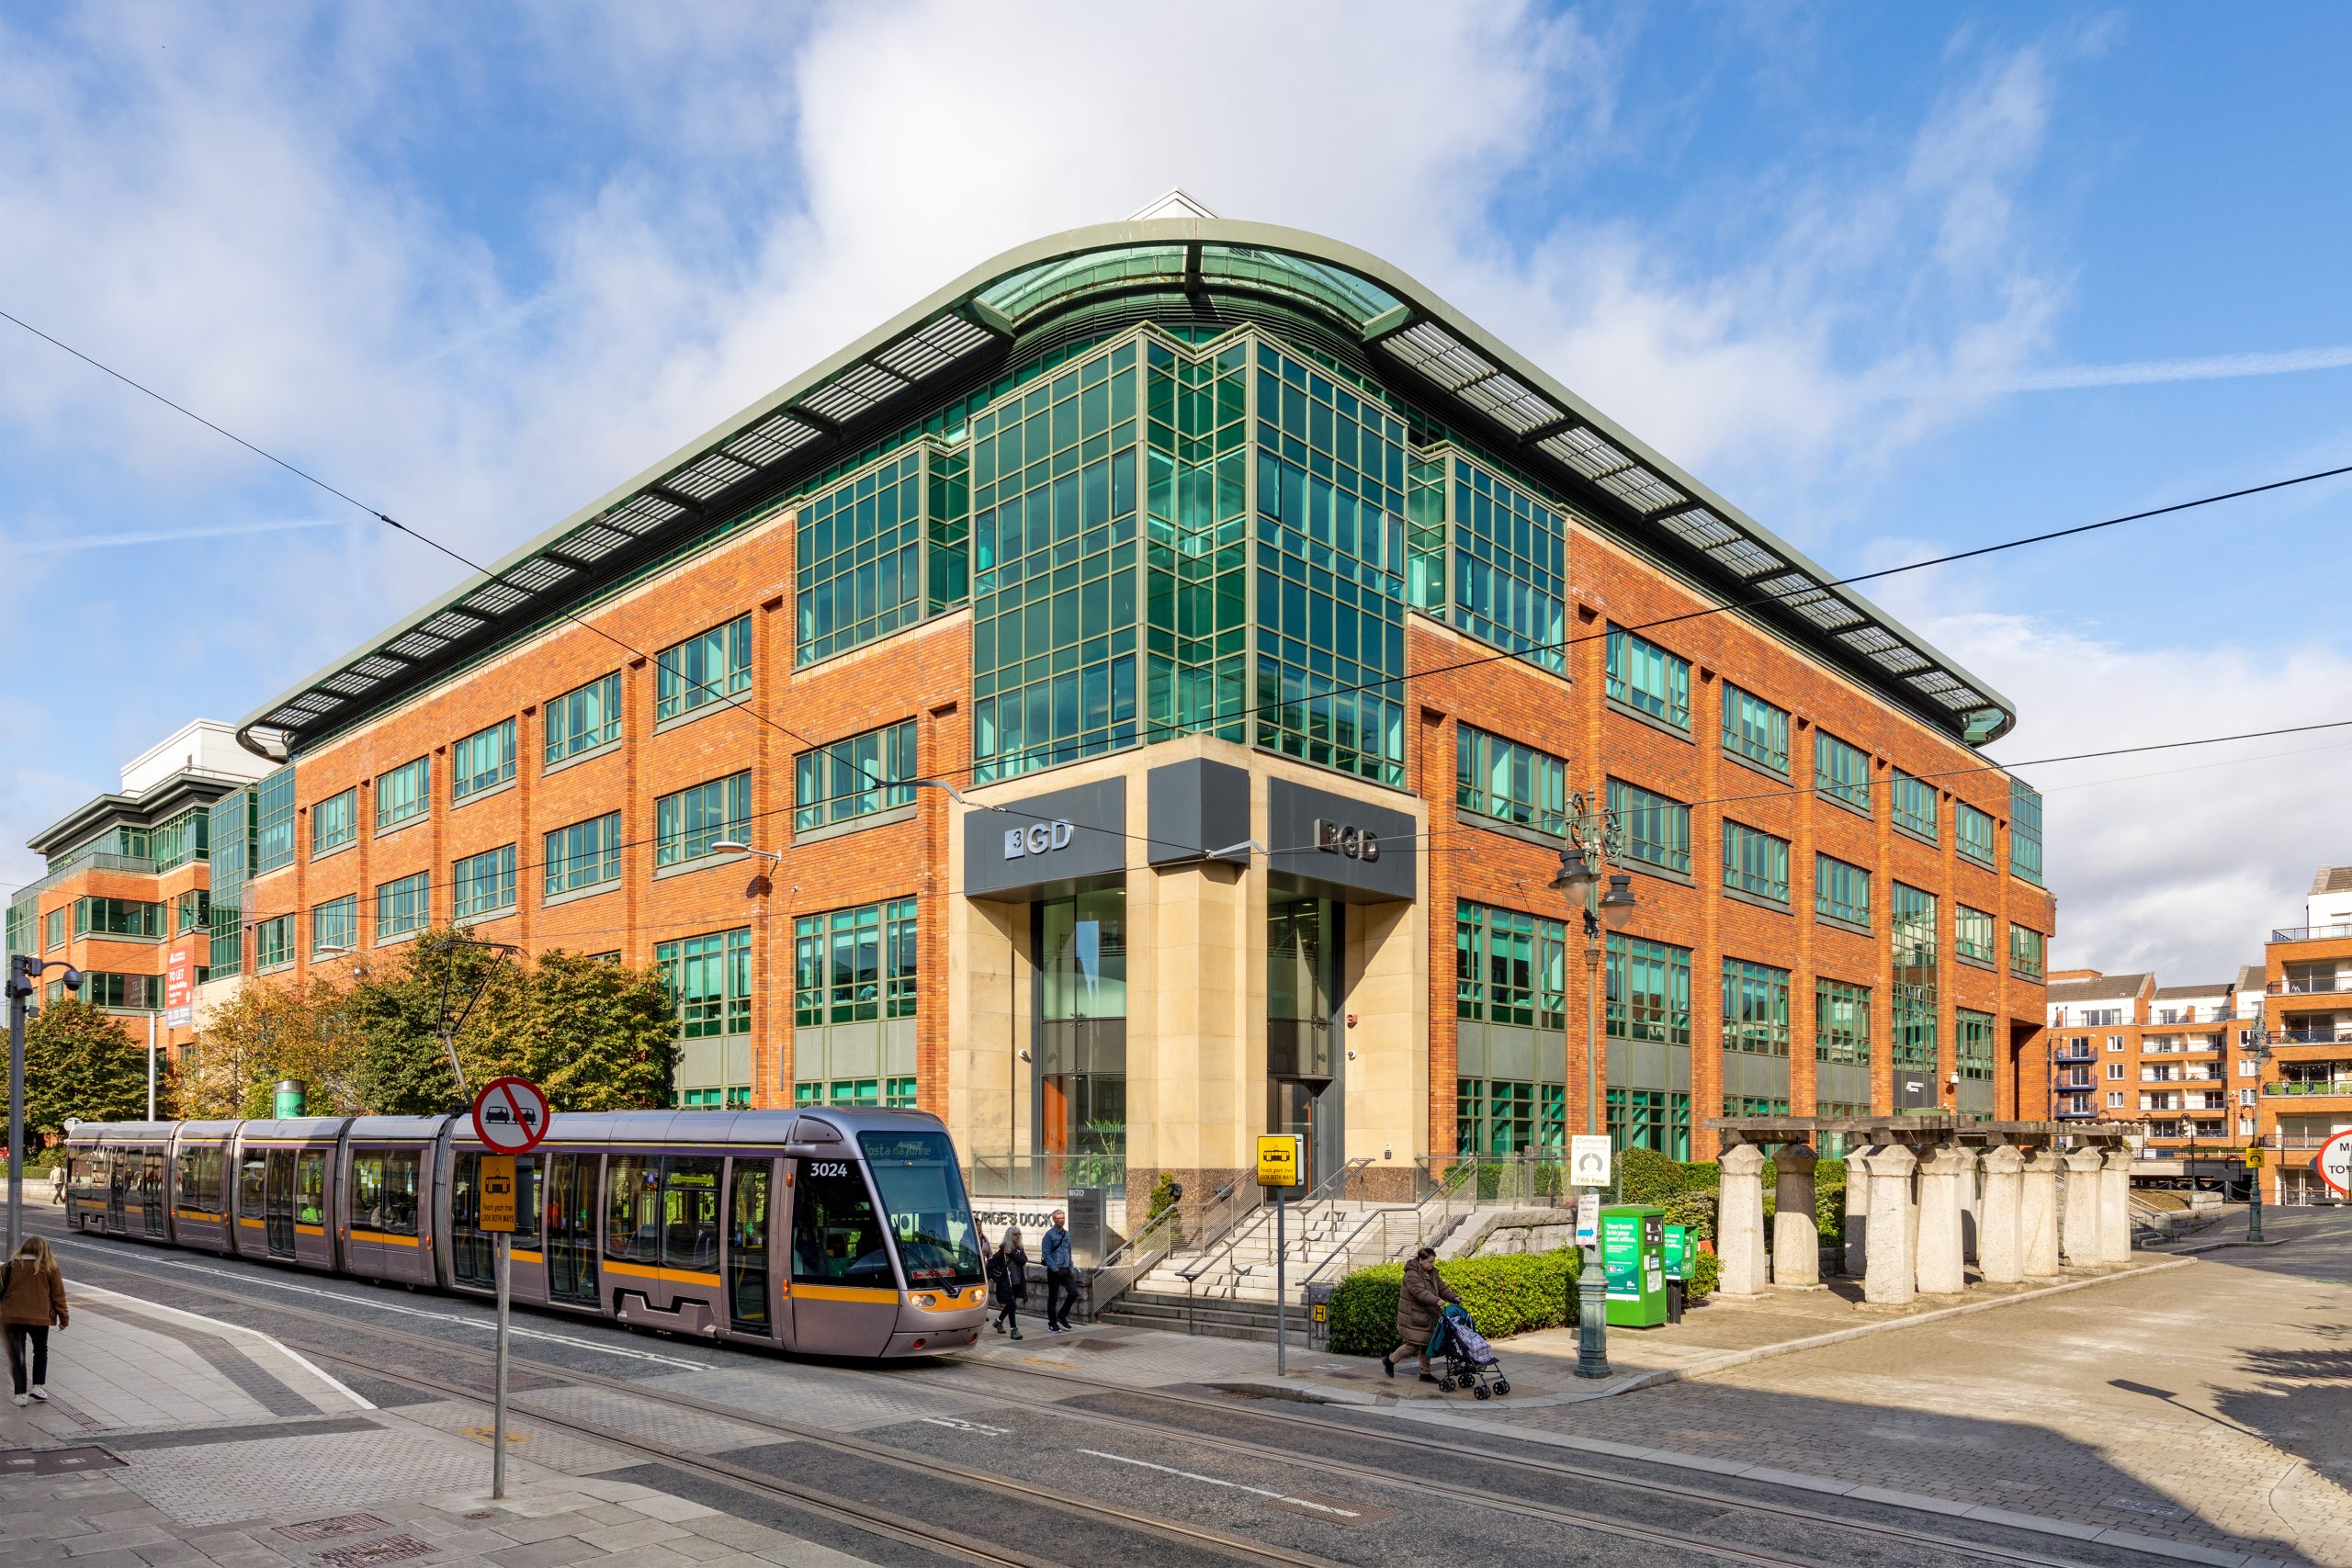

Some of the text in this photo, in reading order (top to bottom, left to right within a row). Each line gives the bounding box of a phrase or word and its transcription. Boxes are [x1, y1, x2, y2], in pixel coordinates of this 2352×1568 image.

[1005, 819, 1074, 859] 3GD
[169, 968, 185, 981] TO LET
[893, 1147, 905, 1156] na
[810, 1163, 847, 1177] 3024
[481, 1213, 514, 1223] LOOK BOTH WAYS
[1019, 1213, 1053, 1227] DOCK
